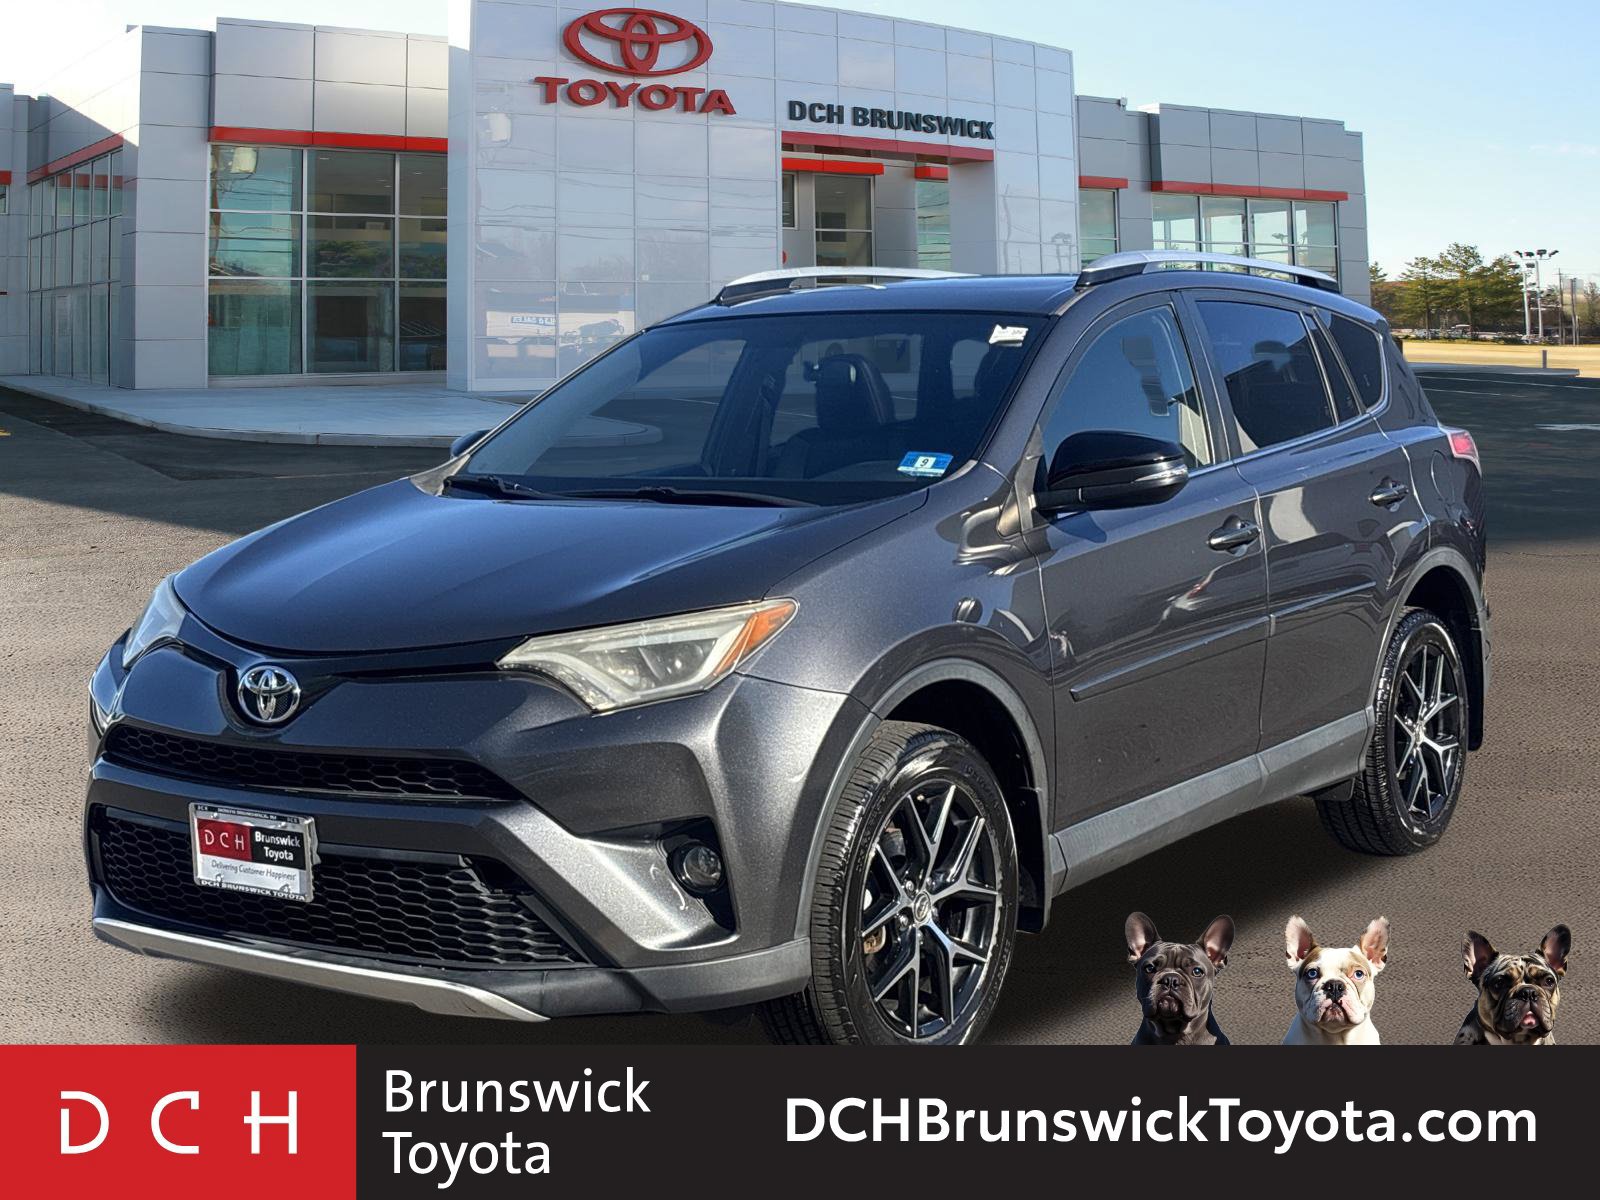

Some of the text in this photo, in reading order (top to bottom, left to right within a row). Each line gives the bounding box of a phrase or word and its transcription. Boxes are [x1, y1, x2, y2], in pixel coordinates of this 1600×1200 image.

[534, 77, 736, 115] TOYOTA
[789, 100, 995, 140] DCH BRUNSWICK
[919, 458, 929, 467] 9
[254, 831, 301, 847] Brunswick
[263, 847, 294, 862] Toyota
[211, 859, 296, 882] Delivering Customer Happiness
[201, 879, 306, 901] DCH BRUNSWICK TOYOTA
